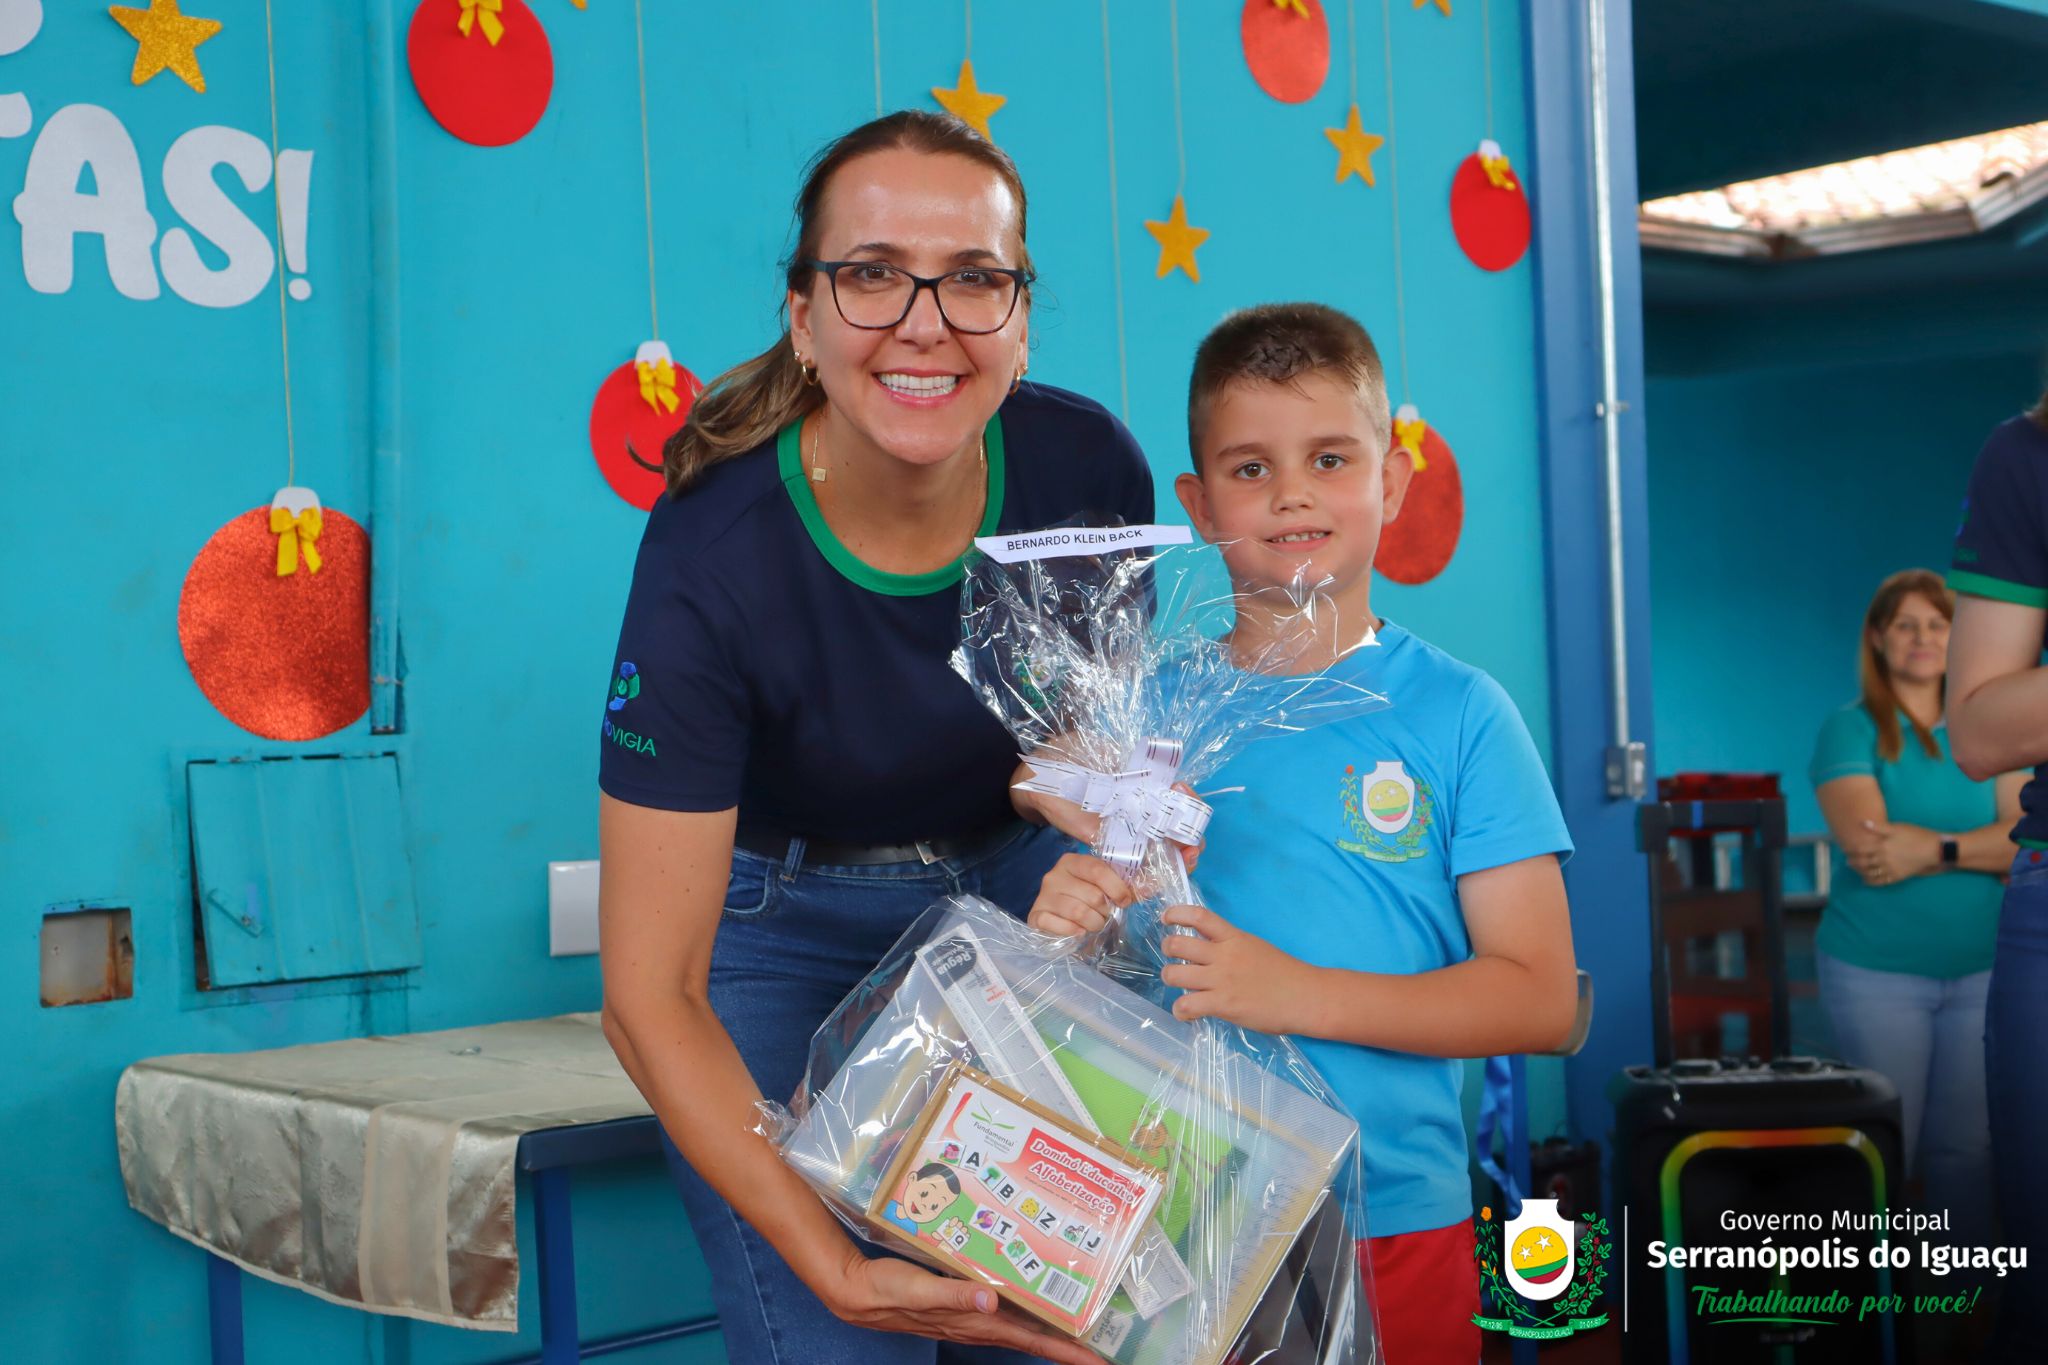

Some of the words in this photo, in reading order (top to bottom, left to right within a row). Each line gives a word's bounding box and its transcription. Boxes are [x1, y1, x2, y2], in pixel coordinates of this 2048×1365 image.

[1007, 534, 1071, 551] BERNARDO
[1074, 533, 1106, 545] KLEIN
[1109, 529, 1144, 542] BACK
[604, 716, 656, 757] OVIGIA
[936, 951, 972, 975] Régua
[973, 1121, 1015, 1147] Fundamental
[966, 1151, 980, 1167] A
[1031, 1139, 1079, 1171] Dominó
[1080, 1161, 1135, 1203] Educativo
[999, 1183, 1015, 1199] B
[1030, 1162, 1115, 1214] Alfabetização
[1000, 1221, 1013, 1236] T
[1039, 1211, 1057, 1230] Z
[954, 1234, 965, 1246] Q
[1087, 1236, 1101, 1249] J
[1023, 1258, 1040, 1271] F
